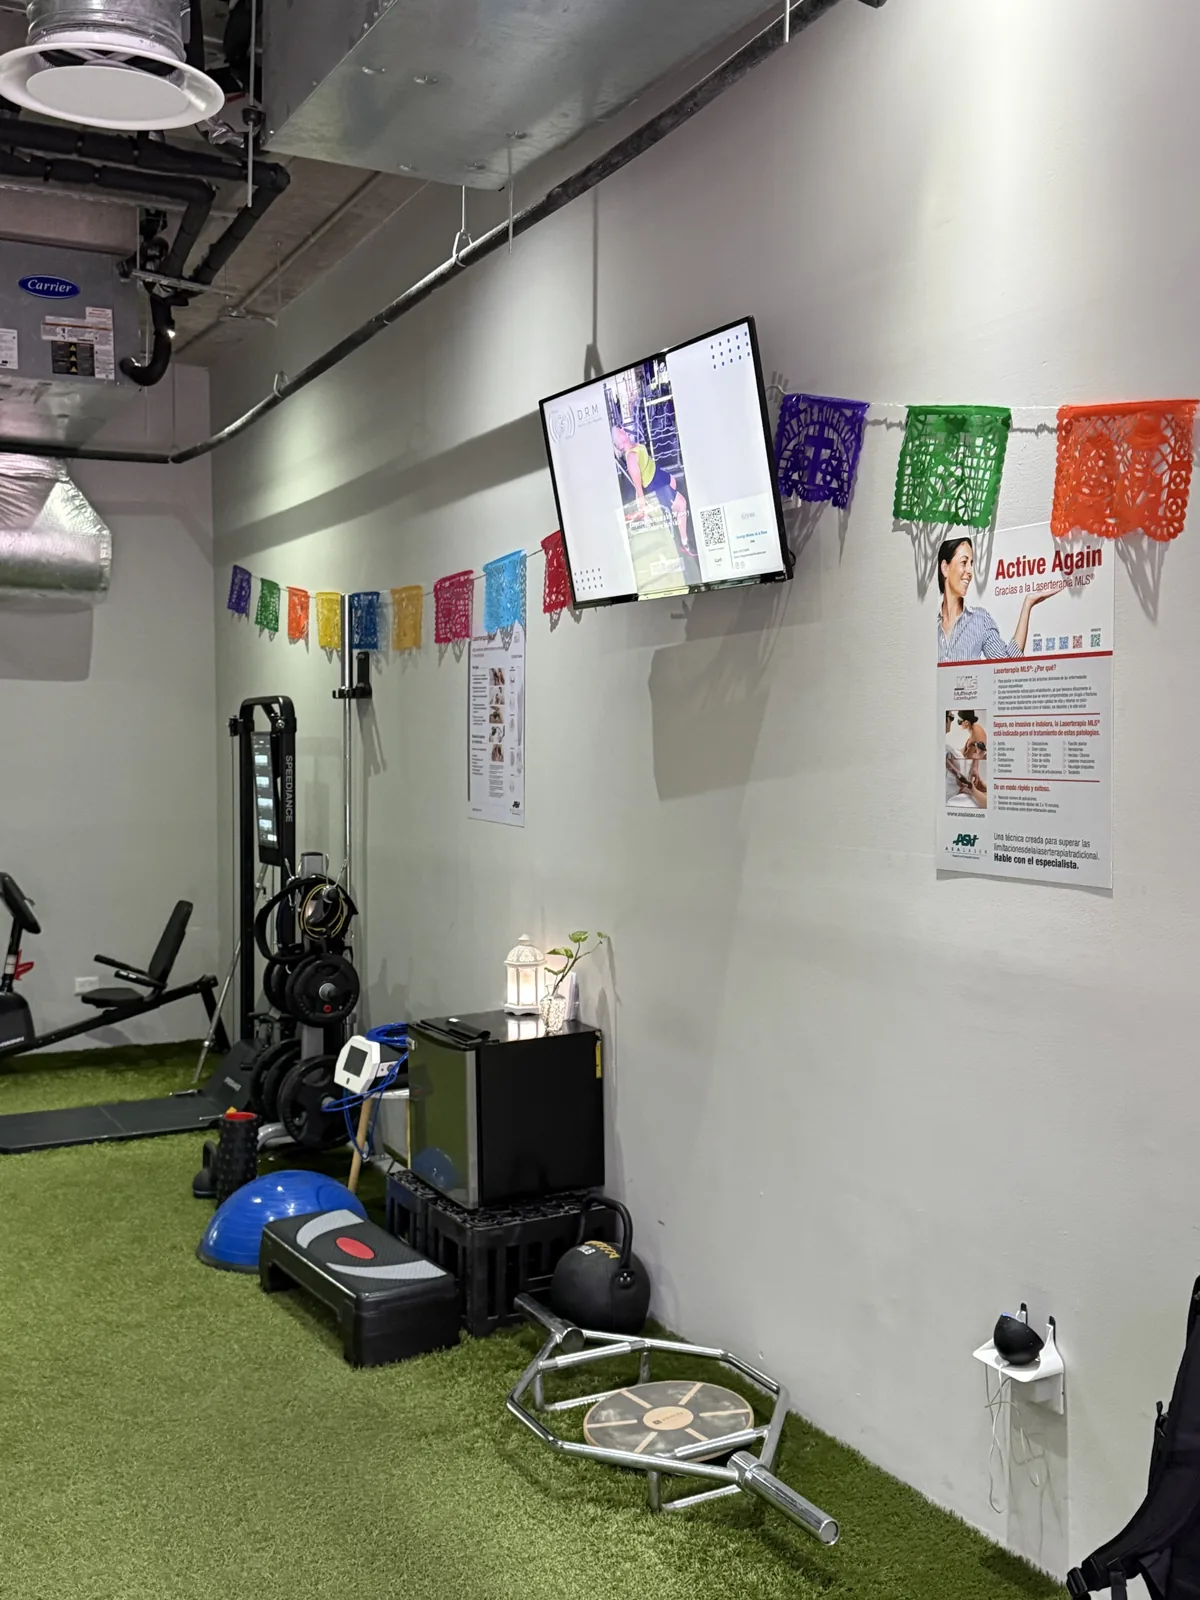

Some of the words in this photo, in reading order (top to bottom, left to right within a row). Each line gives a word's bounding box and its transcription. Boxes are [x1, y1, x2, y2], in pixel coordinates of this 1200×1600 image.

[27, 279, 72, 292] Carrier
[995, 555, 1046, 580] Active
[1051, 545, 1102, 576] Again
[995, 585, 1018, 597] Gracias
[1025, 582, 1030, 592] la
[1032, 576, 1073, 592] Laserterapia
[285, 755, 294, 823] SPEEDIANCE
[994, 832, 1004, 841] Una
[1005, 833, 1024, 843] técnica
[1025, 835, 1044, 844] creada
[1045, 837, 1057, 846] para
[1059, 838, 1081, 848] superar
[1082, 839, 1090, 848] las
[994, 852, 1012, 863] Hable
[1013, 856, 1026, 865] con
[1028, 856, 1034, 865] el
[1035, 858, 1080, 870] especialista.
